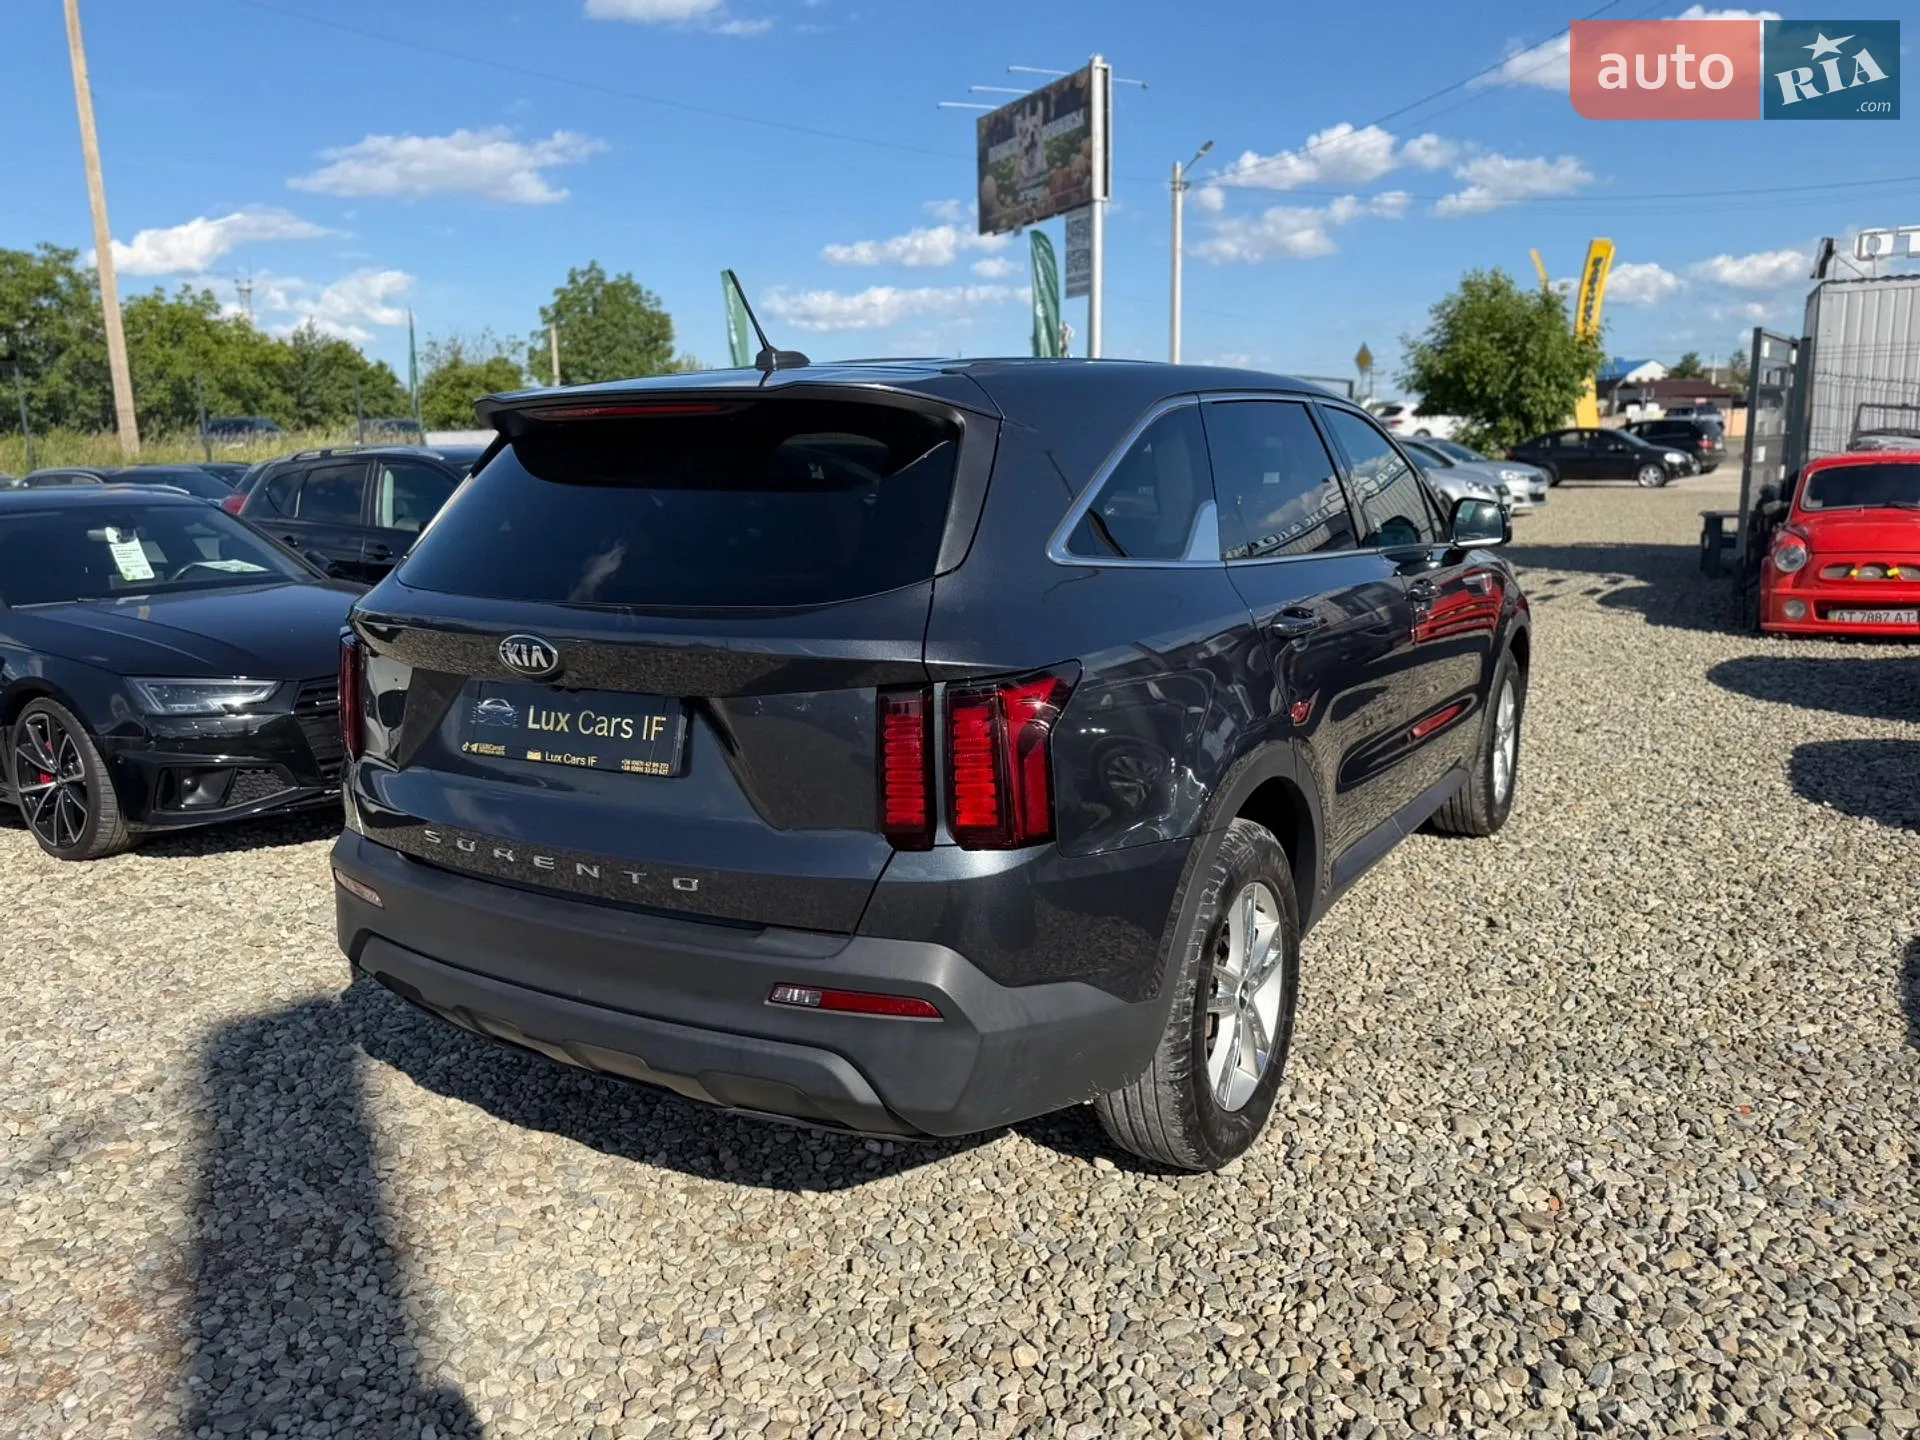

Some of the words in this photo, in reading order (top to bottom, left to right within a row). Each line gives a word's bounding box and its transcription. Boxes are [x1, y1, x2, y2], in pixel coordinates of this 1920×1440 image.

[505, 643, 549, 668] KIA
[527, 704, 571, 733] Lux
[578, 709, 634, 739] Cars
[642, 715, 667, 741] IF
[545, 751, 563, 763] Lux
[563, 753, 586, 766] Cars
[587, 755, 598, 767] IF
[424, 829, 699, 892] SORENTO
